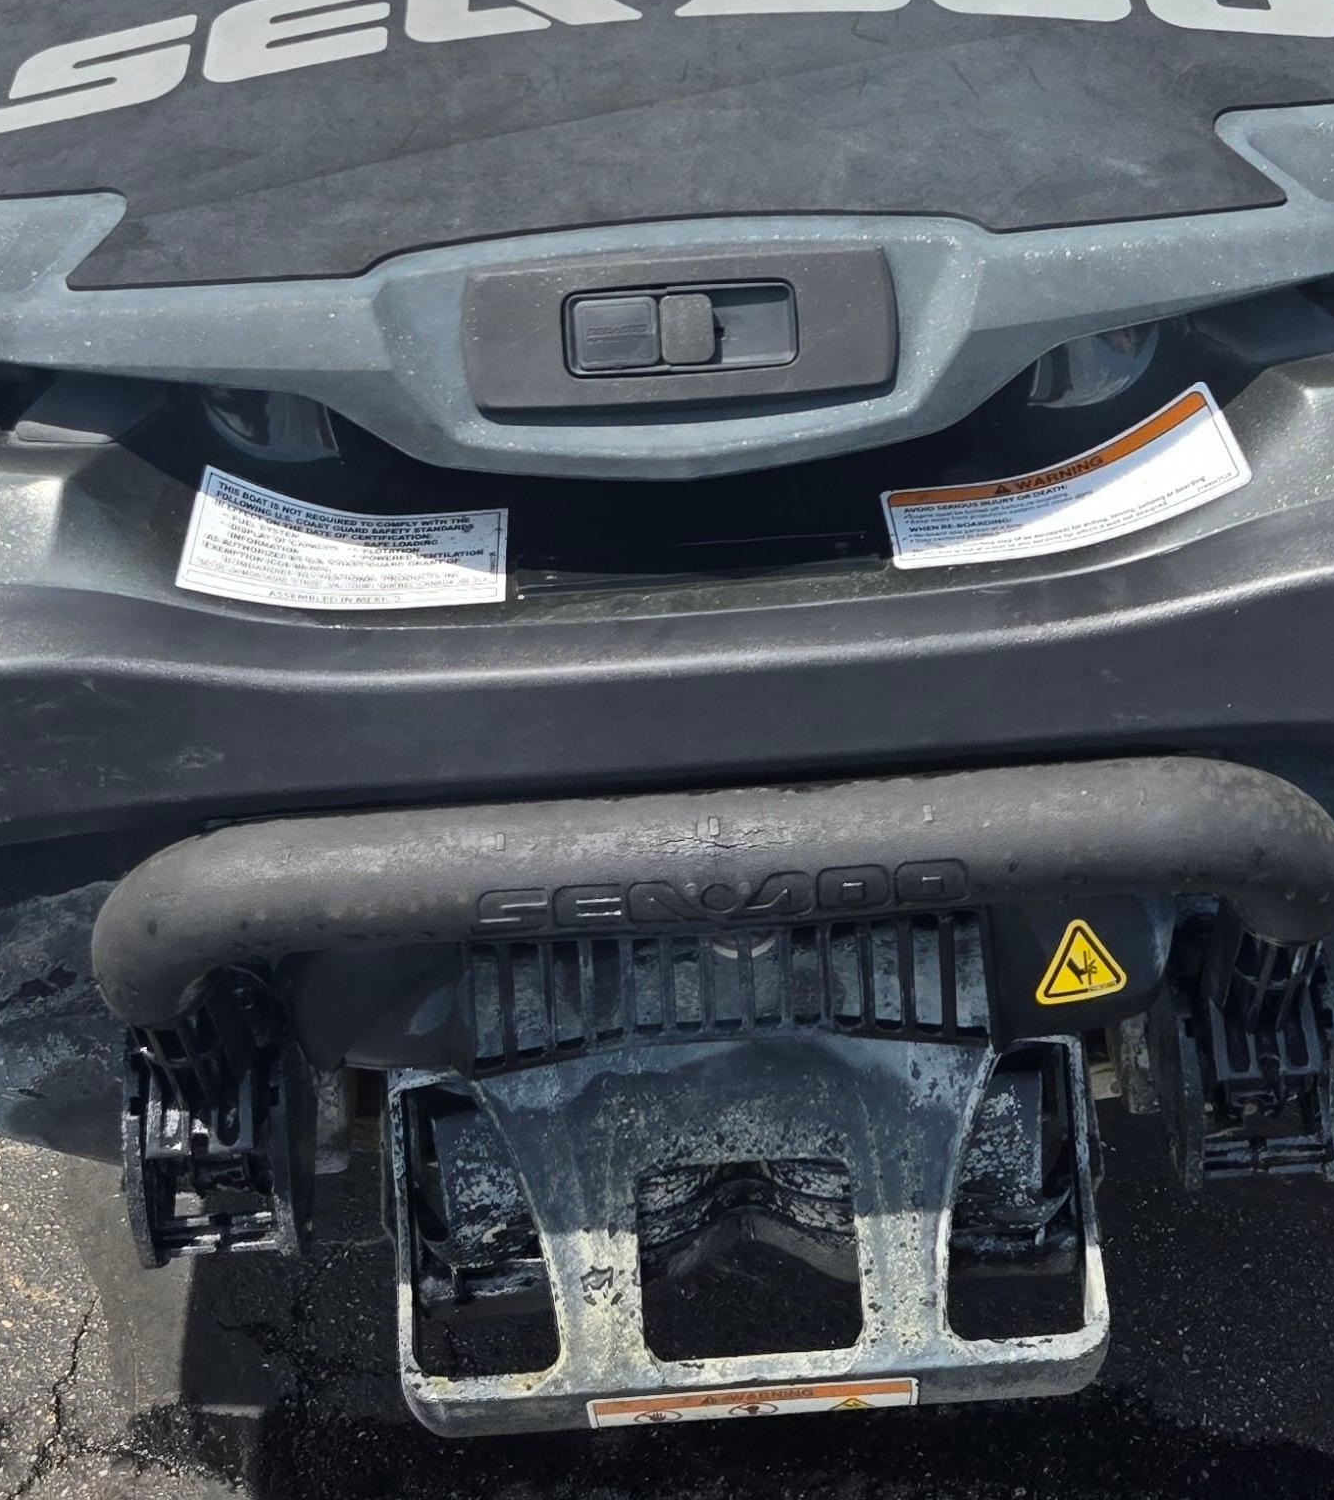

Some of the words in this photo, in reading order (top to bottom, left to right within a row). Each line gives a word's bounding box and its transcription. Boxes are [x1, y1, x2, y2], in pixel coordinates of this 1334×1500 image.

[1016, 455, 1103, 490] WARNING
[216, 490, 271, 517] FOLLOWING
[275, 512, 292, 522] U.S.
[296, 516, 329, 530] COAST
[333, 525, 368, 534] GUARD
[371, 526, 411, 535] SAFETY
[413, 523, 475, 534] STANDARDS
[218, 481, 240, 497] THIS
[242, 490, 267, 507] BOAT
[270, 502, 280, 511] IS
[282, 505, 303, 517] NOT
[305, 511, 357, 527] REQUIRED
[376, 520, 418, 528] COMPLY
[421, 518, 447, 526] WITH
[449, 517, 471, 525] THE
[904, 506, 934, 514] AVOID
[937, 502, 978, 510] SERIOUS
[980, 496, 1013, 506] INJURY
[227, 503, 264, 521] EFFECT
[267, 517, 281, 527] ON
[283, 522, 303, 533] THE
[305, 526, 332, 538] DATE
[351, 533, 433, 541] CERTIFICATION:
[908, 524, 939, 532] WHEN
[363, 546, 419, 554] FLOTATION
[392, 539, 438, 547] LOADING
[414, 549, 483, 559] VENTILATION
